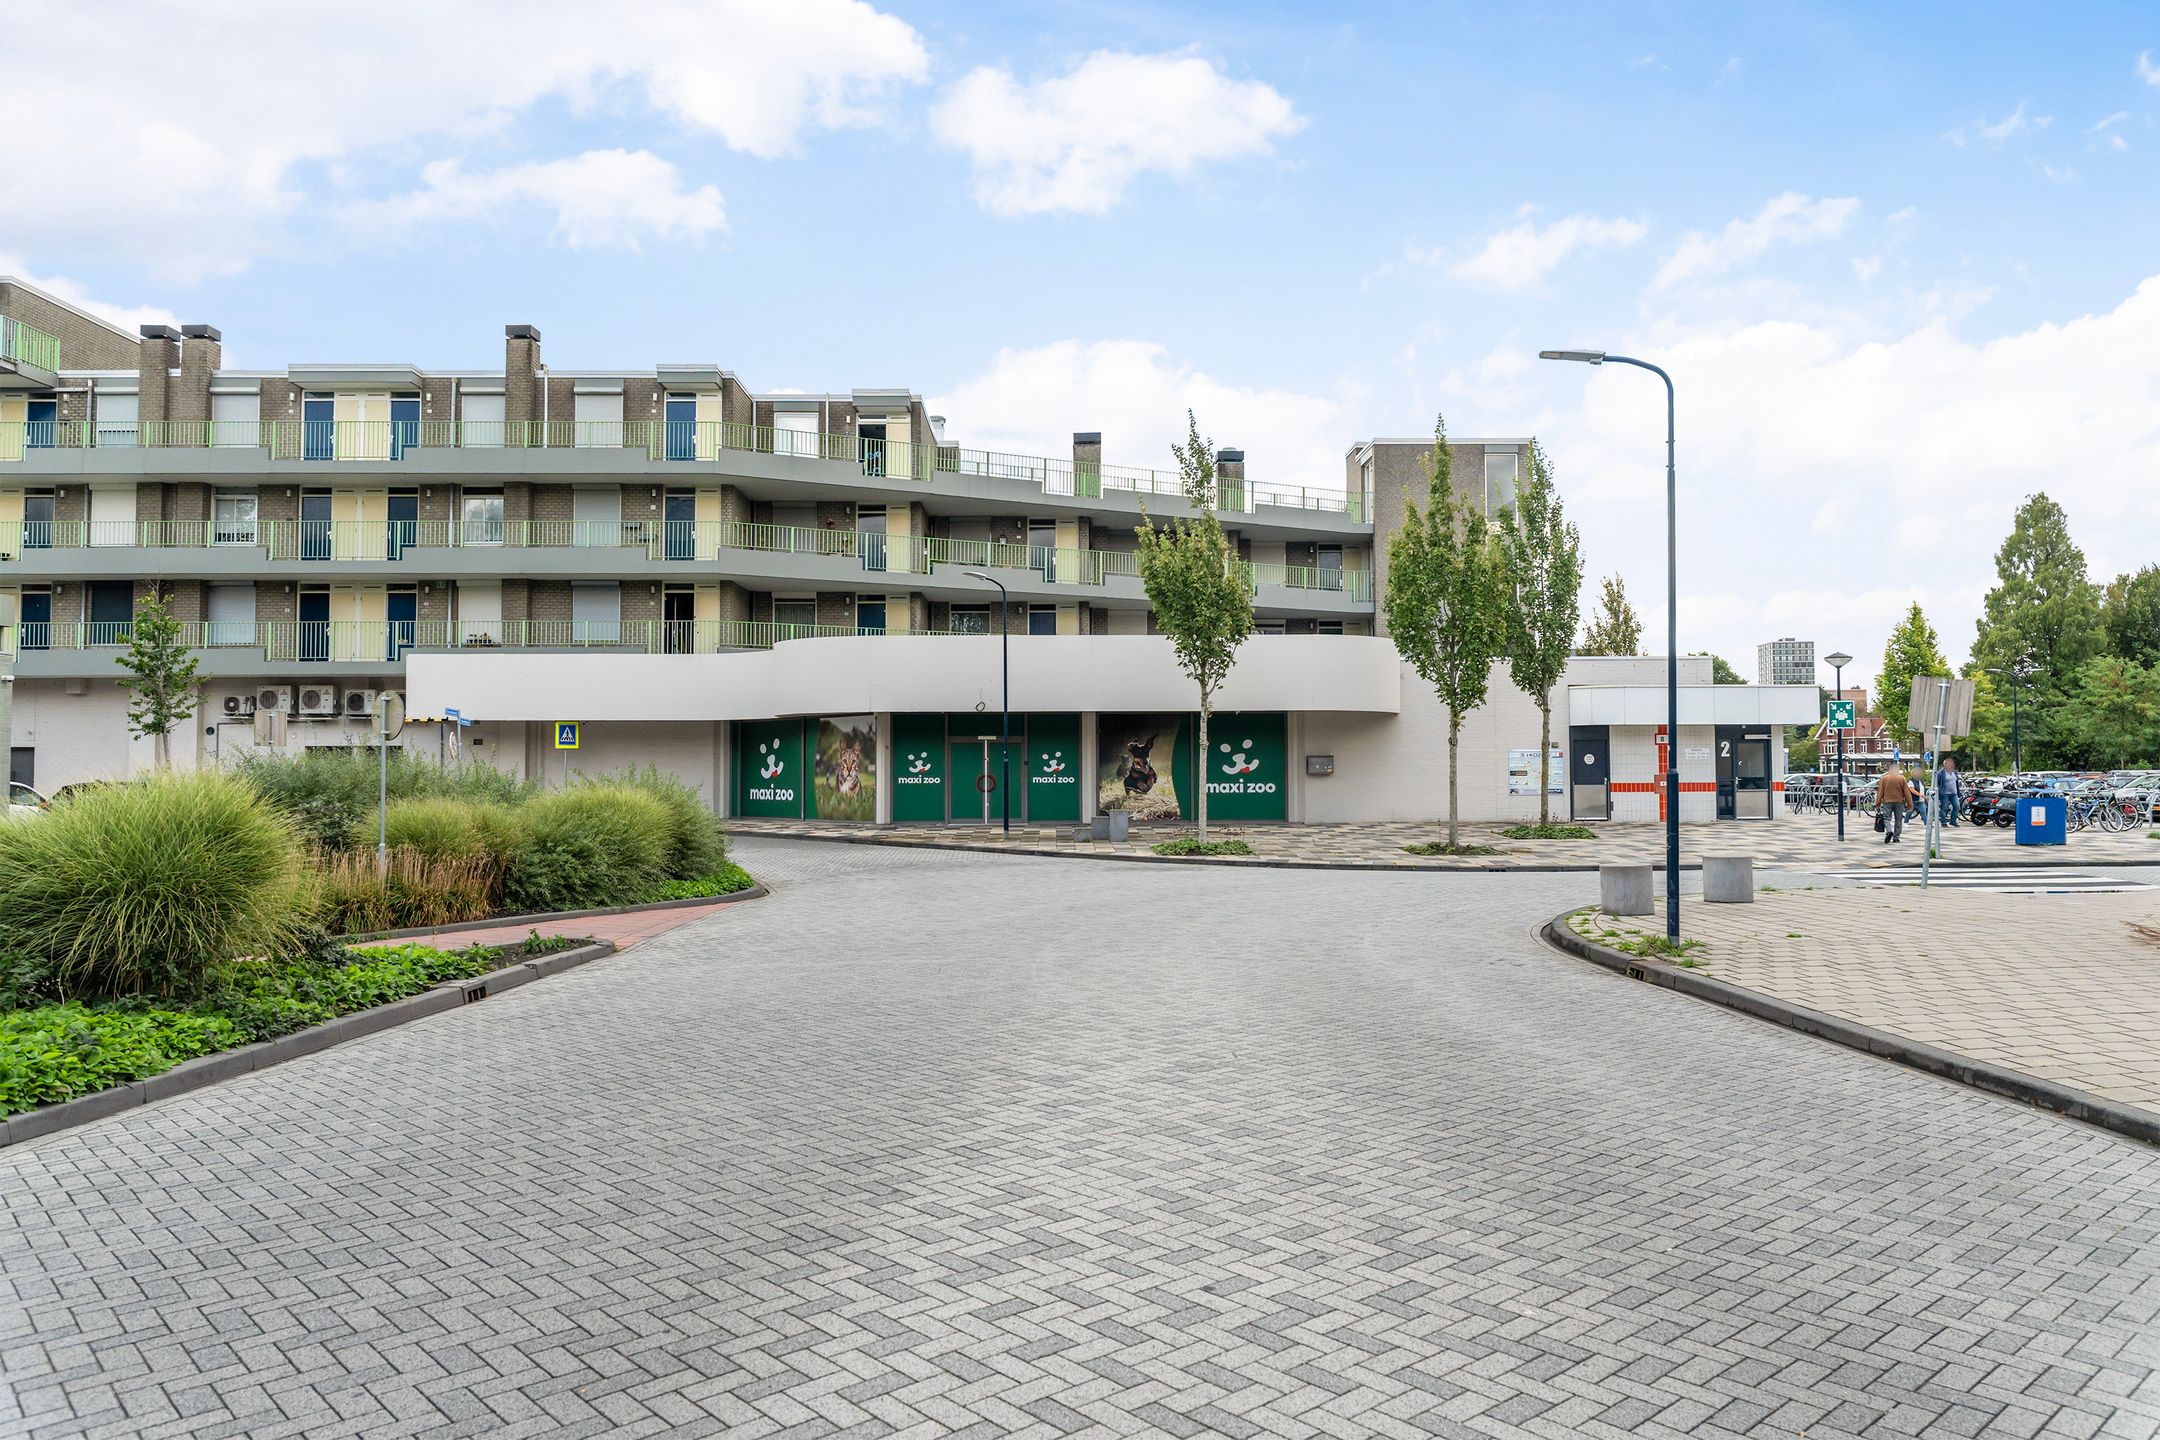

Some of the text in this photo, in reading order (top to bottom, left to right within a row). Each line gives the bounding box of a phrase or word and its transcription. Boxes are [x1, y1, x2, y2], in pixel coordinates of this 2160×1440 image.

[1720, 741, 1730, 757] 2
[898, 774, 922, 784] maxi
[1032, 774, 1056, 783] maxi
[1205, 778, 1276, 793] maxi zoo
[750, 783, 794, 801] maxi zoo
